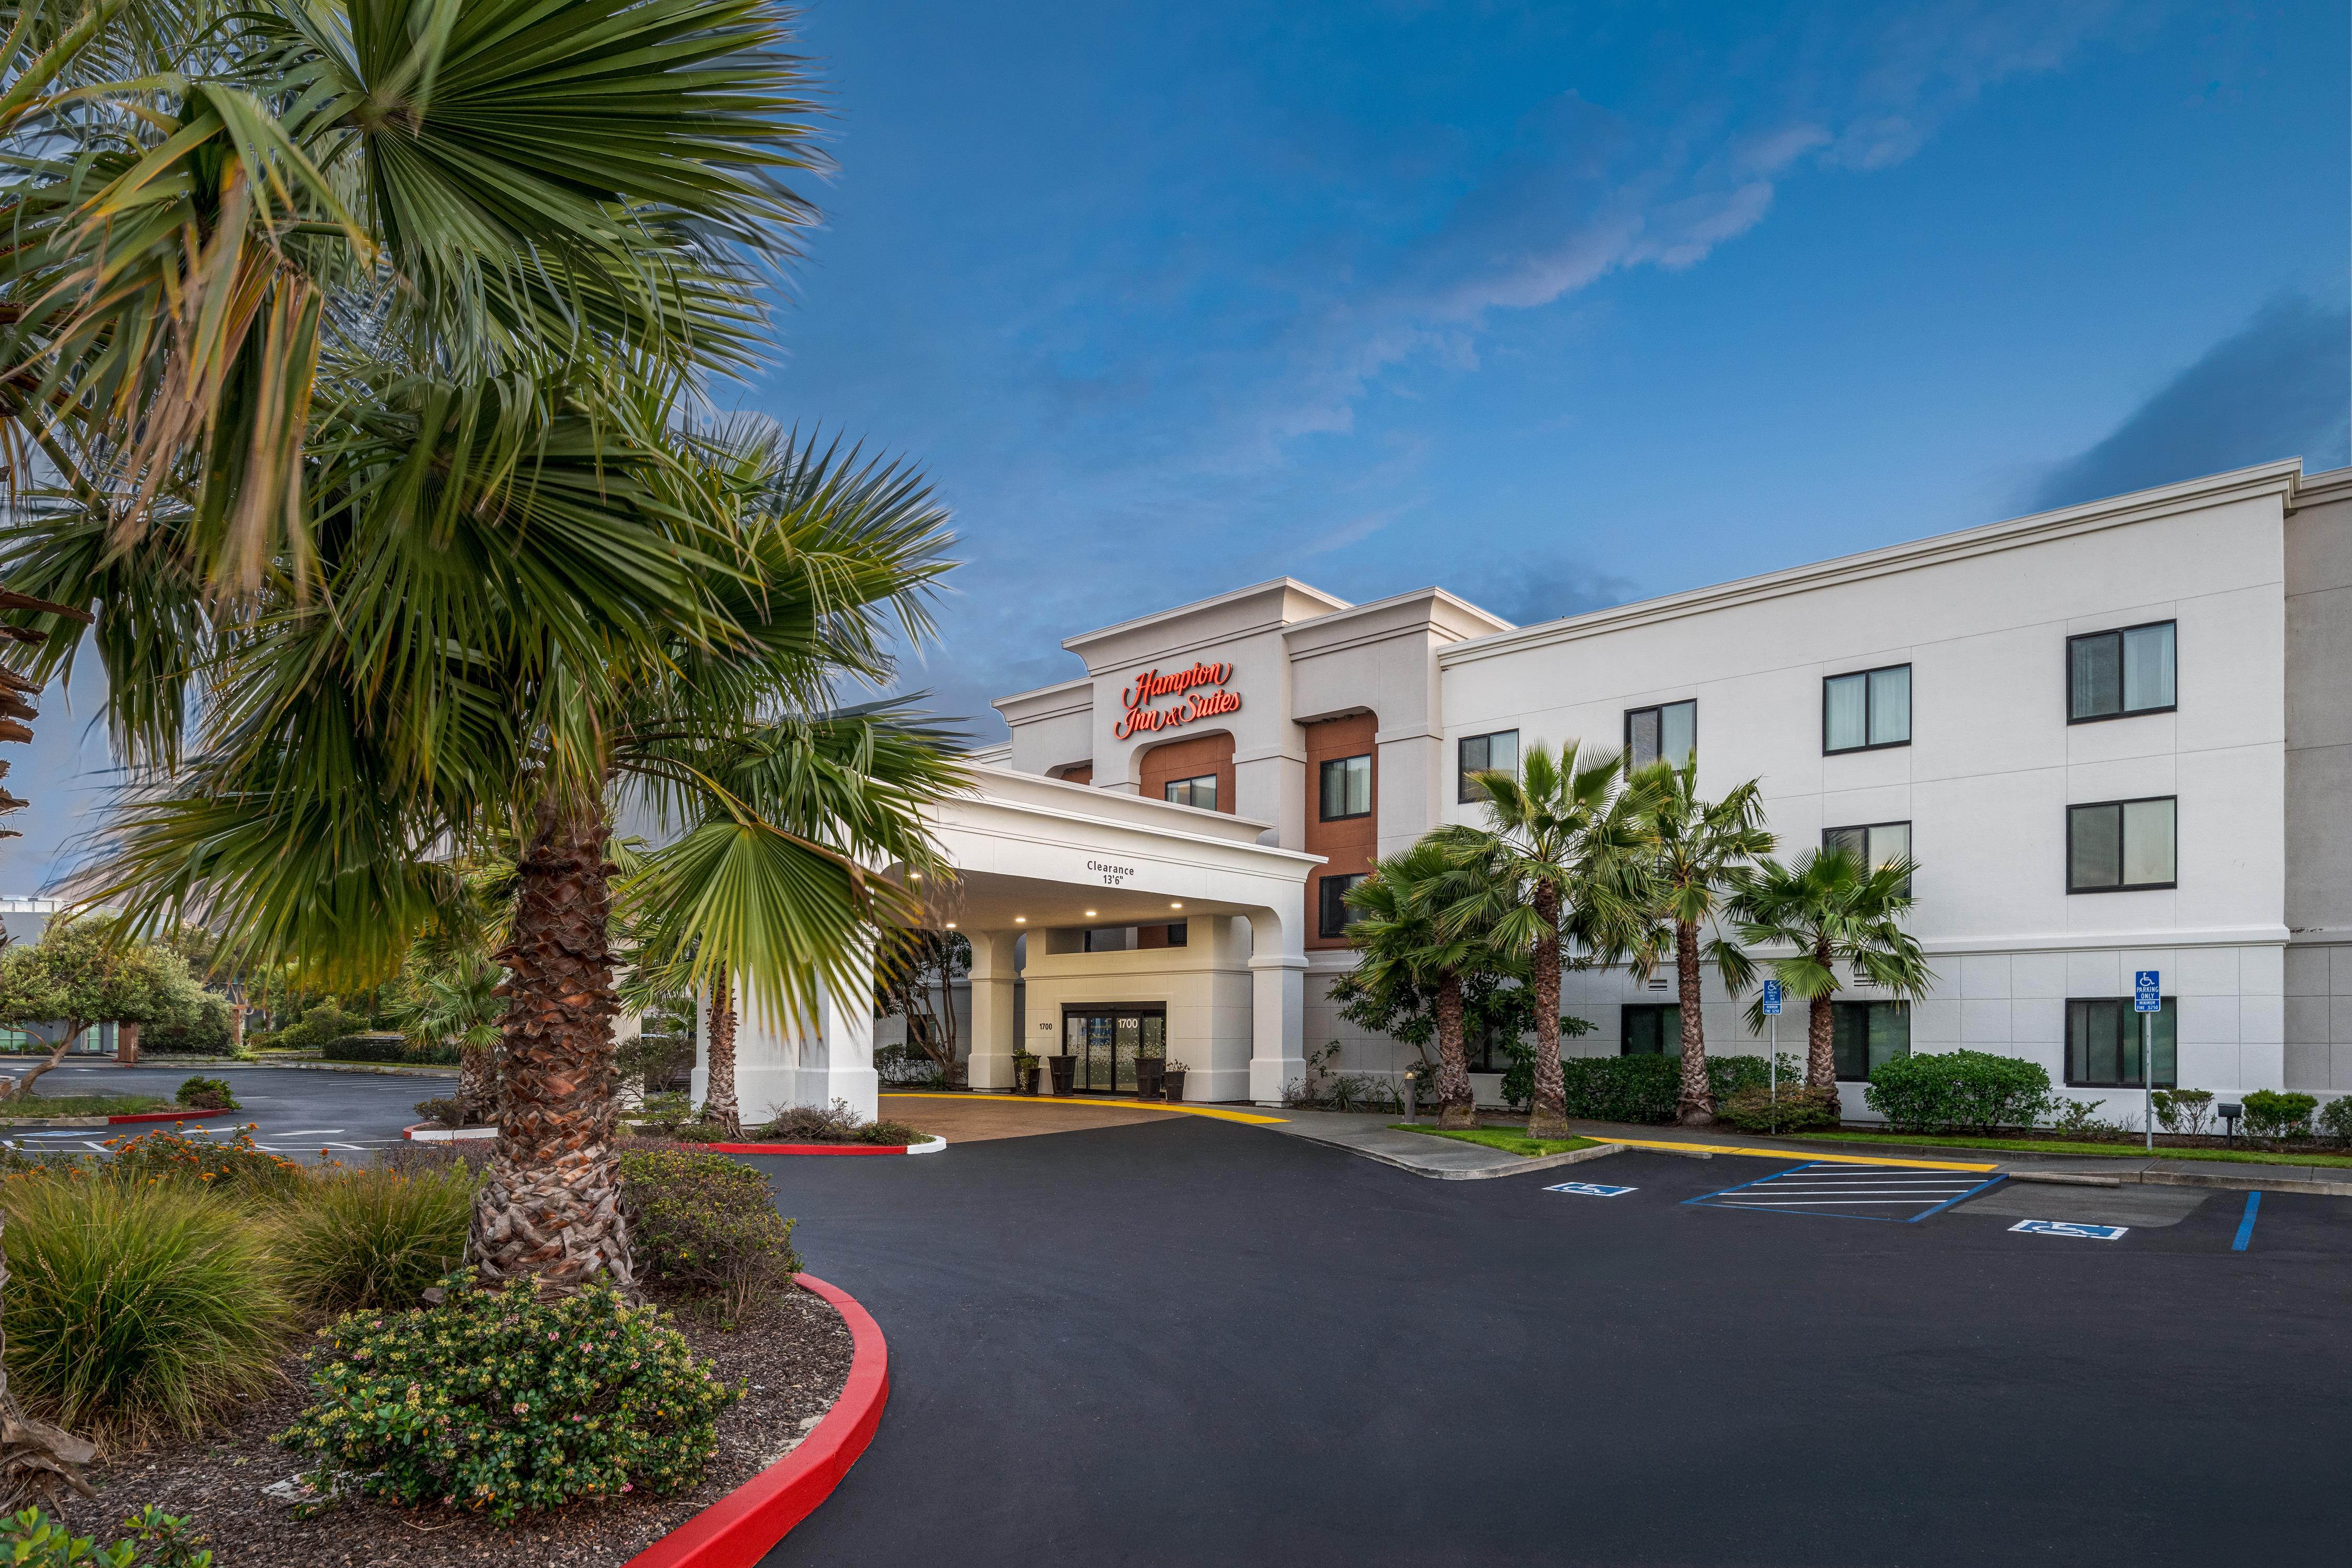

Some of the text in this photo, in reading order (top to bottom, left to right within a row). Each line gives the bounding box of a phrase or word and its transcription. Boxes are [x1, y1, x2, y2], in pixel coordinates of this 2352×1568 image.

[1122, 662, 1233, 710] Hampton
[1114, 689, 1242, 740] Inn & Suites
[1087, 860, 1134, 875] Clearance
[1103, 874, 1123, 885] 13'6"
[1118, 1019, 1138, 1028] 1700
